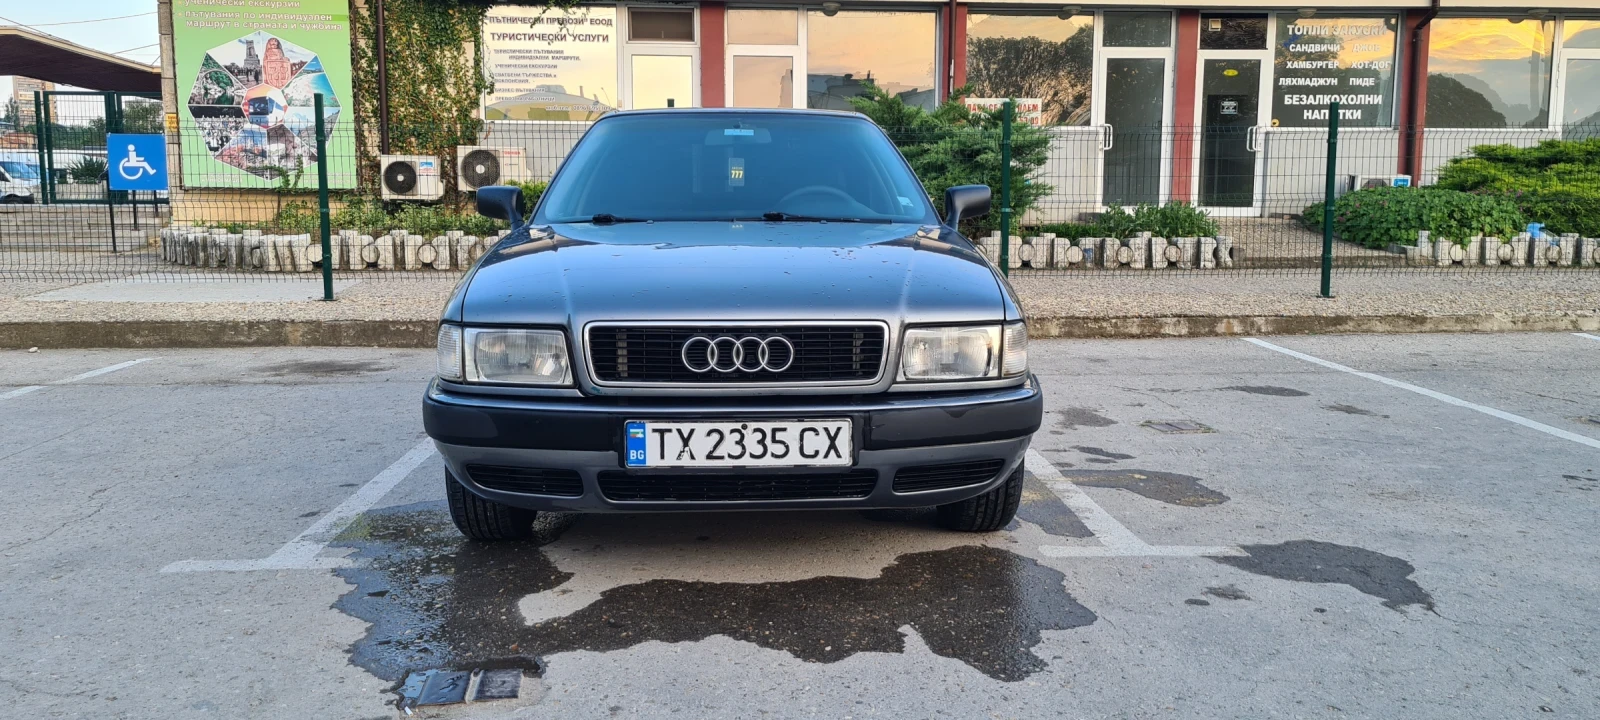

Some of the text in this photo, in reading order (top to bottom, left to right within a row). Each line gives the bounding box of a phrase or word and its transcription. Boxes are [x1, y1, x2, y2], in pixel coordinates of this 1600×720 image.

[185, 11, 240, 19] пътувания
[259, 13, 332, 21] индивидуален
[186, 20, 231, 29] маршрут
[300, 23, 342, 31] чужбина
[590, 18, 613, 27] ЕООД
[1287, 25, 1388, 36] ТОПЛИ ЗАКУСКИ
[490, 32, 609, 42] ТУРИСТИЧЕСКИ УСЛУГИ
[1289, 44, 1341, 53] САНДВИЧИ
[1286, 61, 1391, 70] ХАМБУРГЕР ХОТ-ДОГ
[1278, 78, 1375, 87] ЛЯХМАДЖУН ПИДЕ
[1284, 94, 1382, 105] БЕЗАЛКОХОЛНИ
[1303, 110, 1361, 120] НАПТКИ
[731, 170, 743, 178] 777
[652, 427, 842, 460] TX 2335 CX
[630, 450, 644, 460] BG
